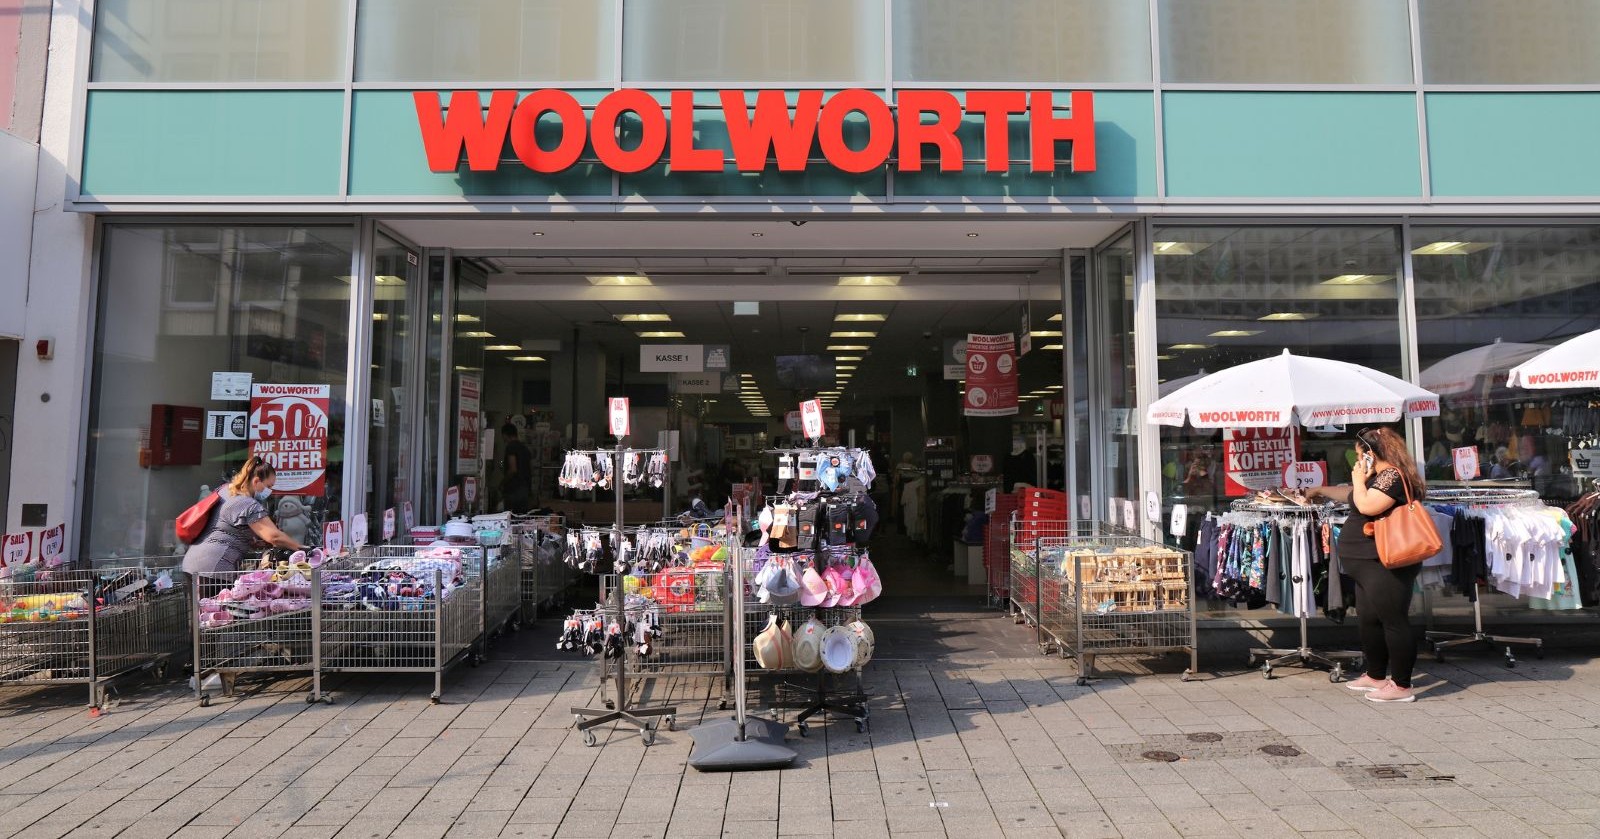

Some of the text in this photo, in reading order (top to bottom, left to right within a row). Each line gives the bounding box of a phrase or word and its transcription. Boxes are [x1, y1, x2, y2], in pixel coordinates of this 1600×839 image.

[412, 88, 1096, 173] WOOLWORTH
[655, 354, 689, 362] KASSE 1
[1528, 370, 1599, 385] WOOLWORTH
[260, 385, 320, 395] WOOLWORTH
[805, 402, 816, 414] SALE
[1312, 406, 1396, 419] WWW.WOOLWORTH.DE
[252, 403, 327, 440] -50%
[1199, 410, 1281, 423] WOOLWORTH
[254, 439, 321, 452] AUF TEXTILE
[1228, 440, 1250, 453] AUF
[1295, 462, 1314, 473] SALE
[47, 527, 59, 539] SALE
[329, 522, 339, 533] SALE
[11, 534, 25, 545] SALE
